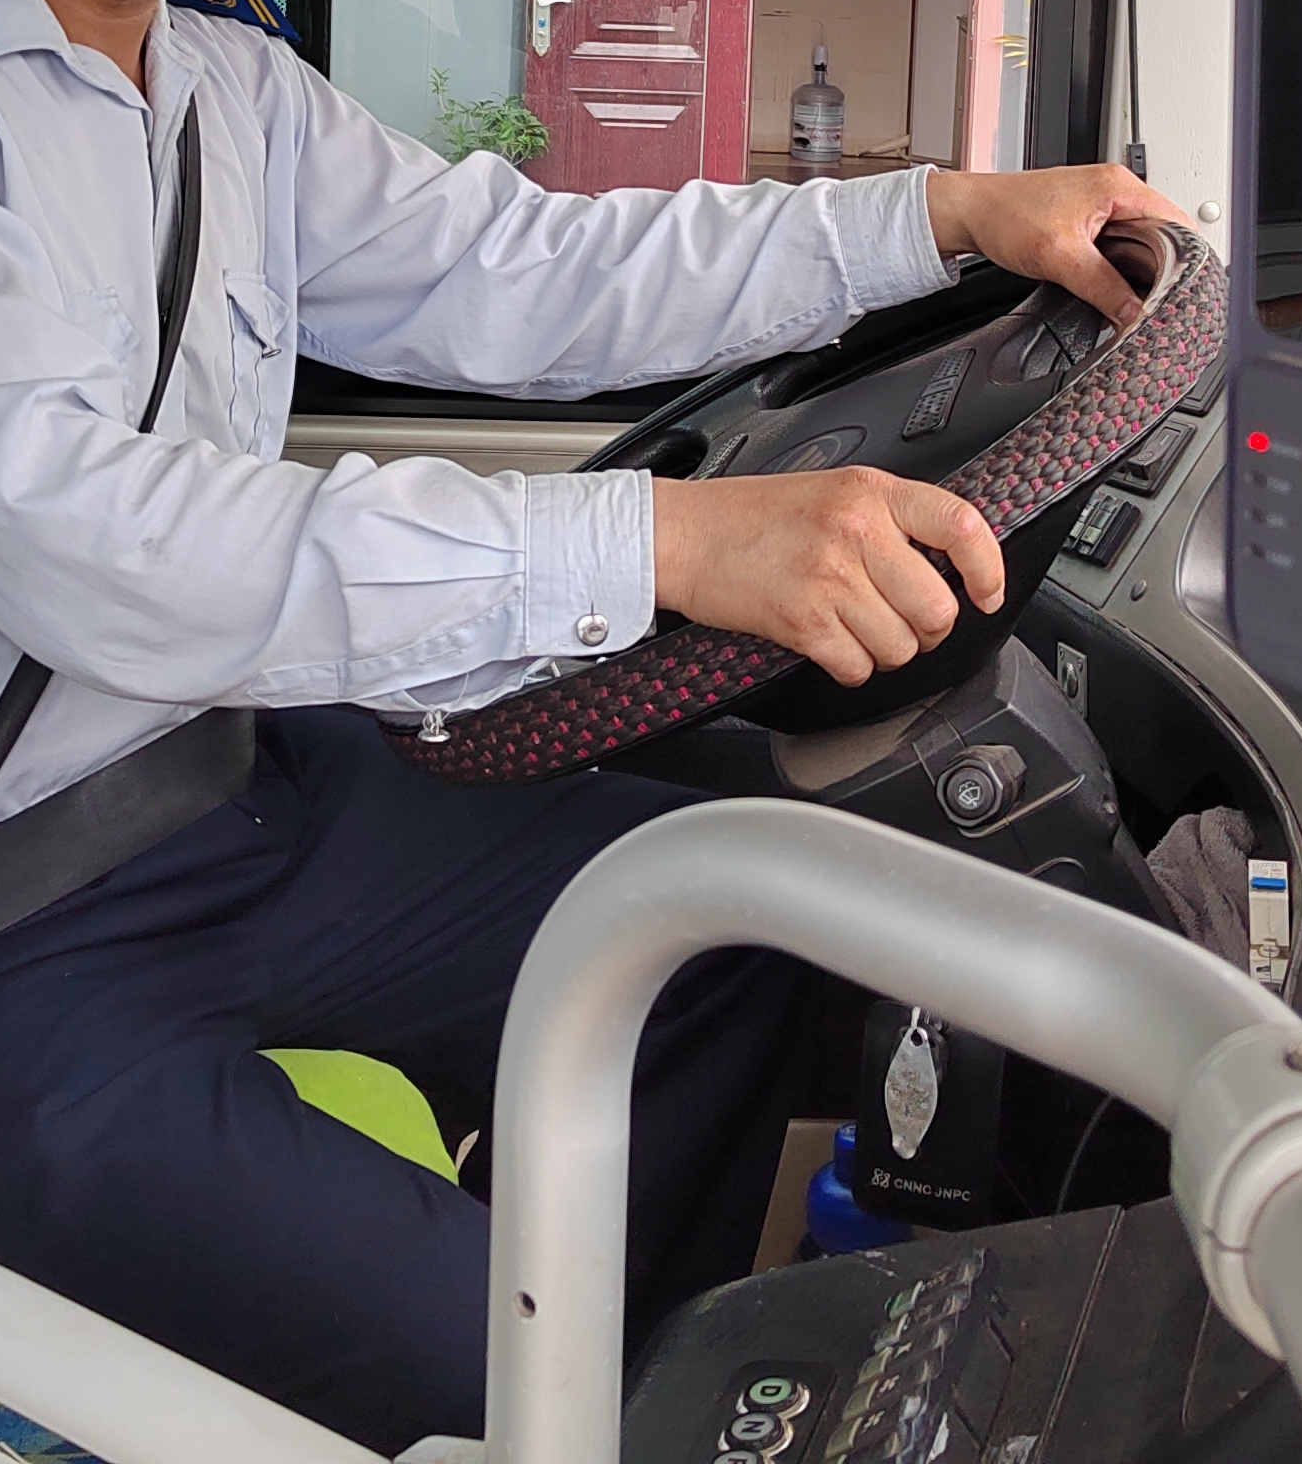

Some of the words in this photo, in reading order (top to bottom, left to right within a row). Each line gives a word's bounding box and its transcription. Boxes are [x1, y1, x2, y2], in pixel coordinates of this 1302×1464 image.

[893, 1177, 932, 1195] CNNC
[934, 1186, 972, 1202] JNPC
[760, 1385, 783, 1398] D
